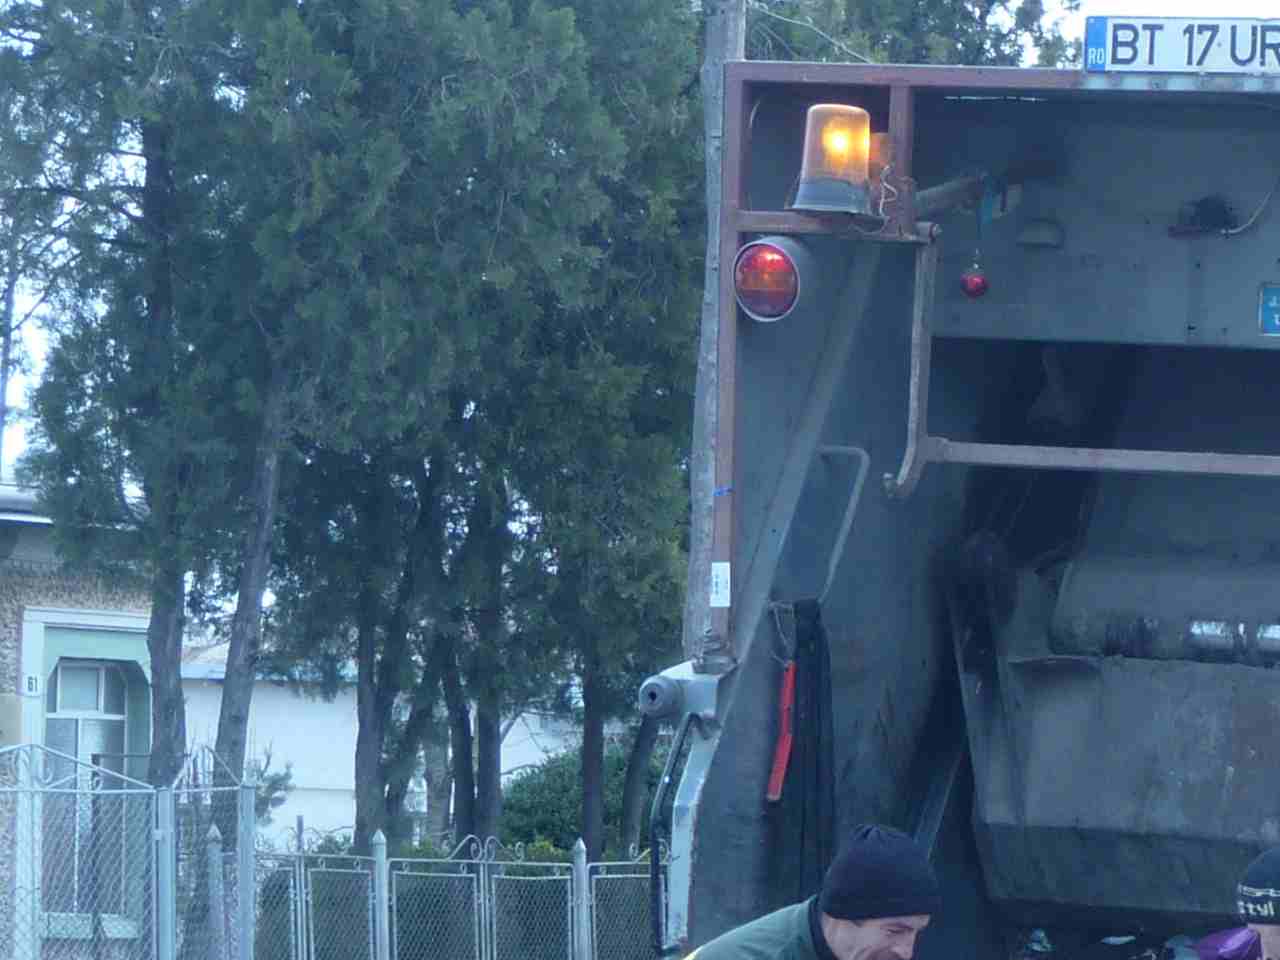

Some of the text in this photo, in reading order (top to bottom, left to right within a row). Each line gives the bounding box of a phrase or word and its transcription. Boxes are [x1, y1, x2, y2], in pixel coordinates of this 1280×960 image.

[1087, 47, 1105, 65] RO
[1110, 23, 1163, 65] BT
[1182, 24, 1220, 66] 17
